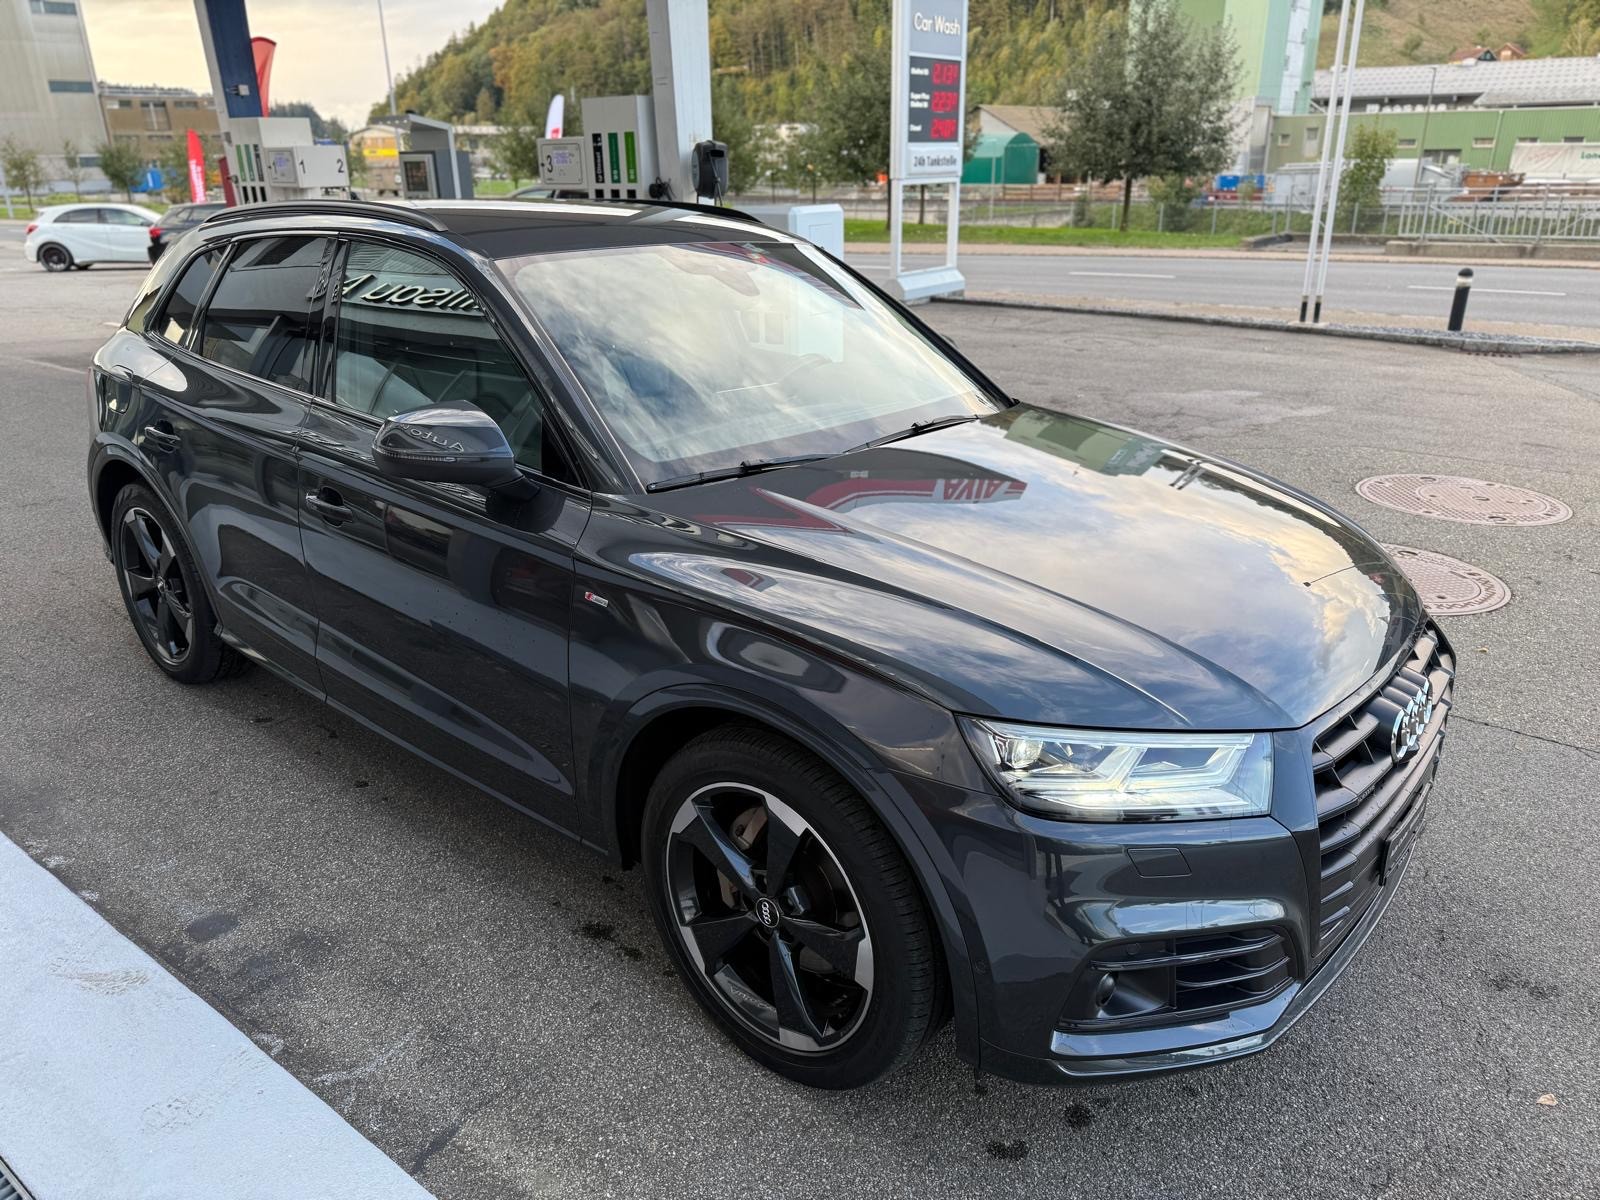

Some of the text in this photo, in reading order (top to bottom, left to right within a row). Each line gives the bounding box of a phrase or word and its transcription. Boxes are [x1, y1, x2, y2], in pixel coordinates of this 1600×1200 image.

[914, 12, 961, 35] Car Wash
[299, 159, 306, 174] 1
[336, 158, 345, 174] 2
[546, 154, 554, 173] 3
[913, 155, 957, 167] 24h Tankstelle
